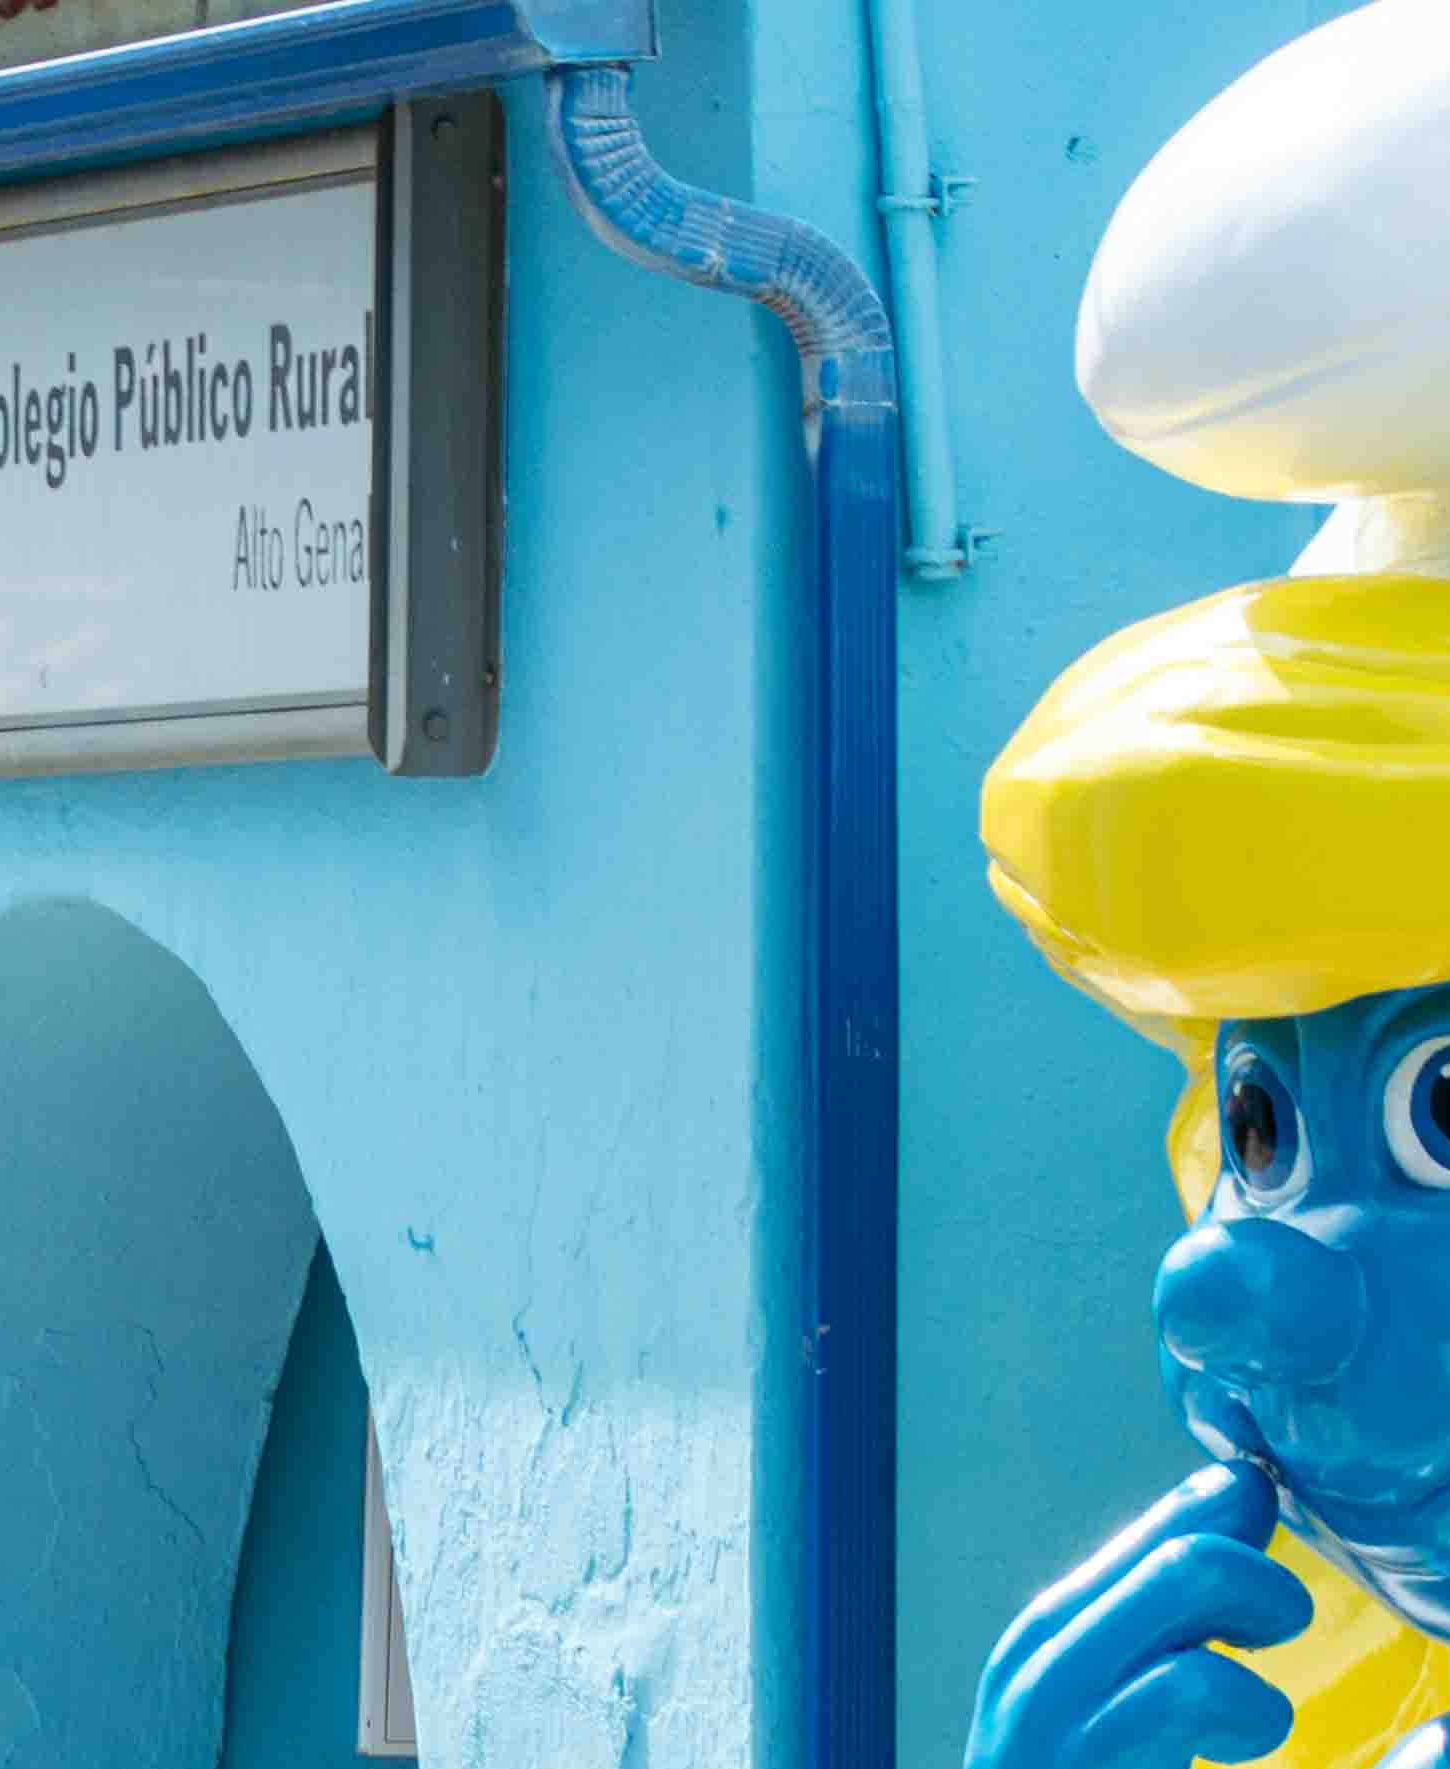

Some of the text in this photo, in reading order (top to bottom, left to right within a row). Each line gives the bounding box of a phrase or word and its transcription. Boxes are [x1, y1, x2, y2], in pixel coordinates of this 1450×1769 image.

[113, 331, 254, 452] Público
[268, 309, 375, 433] Rural
[233, 497, 371, 591] Alto Gena
